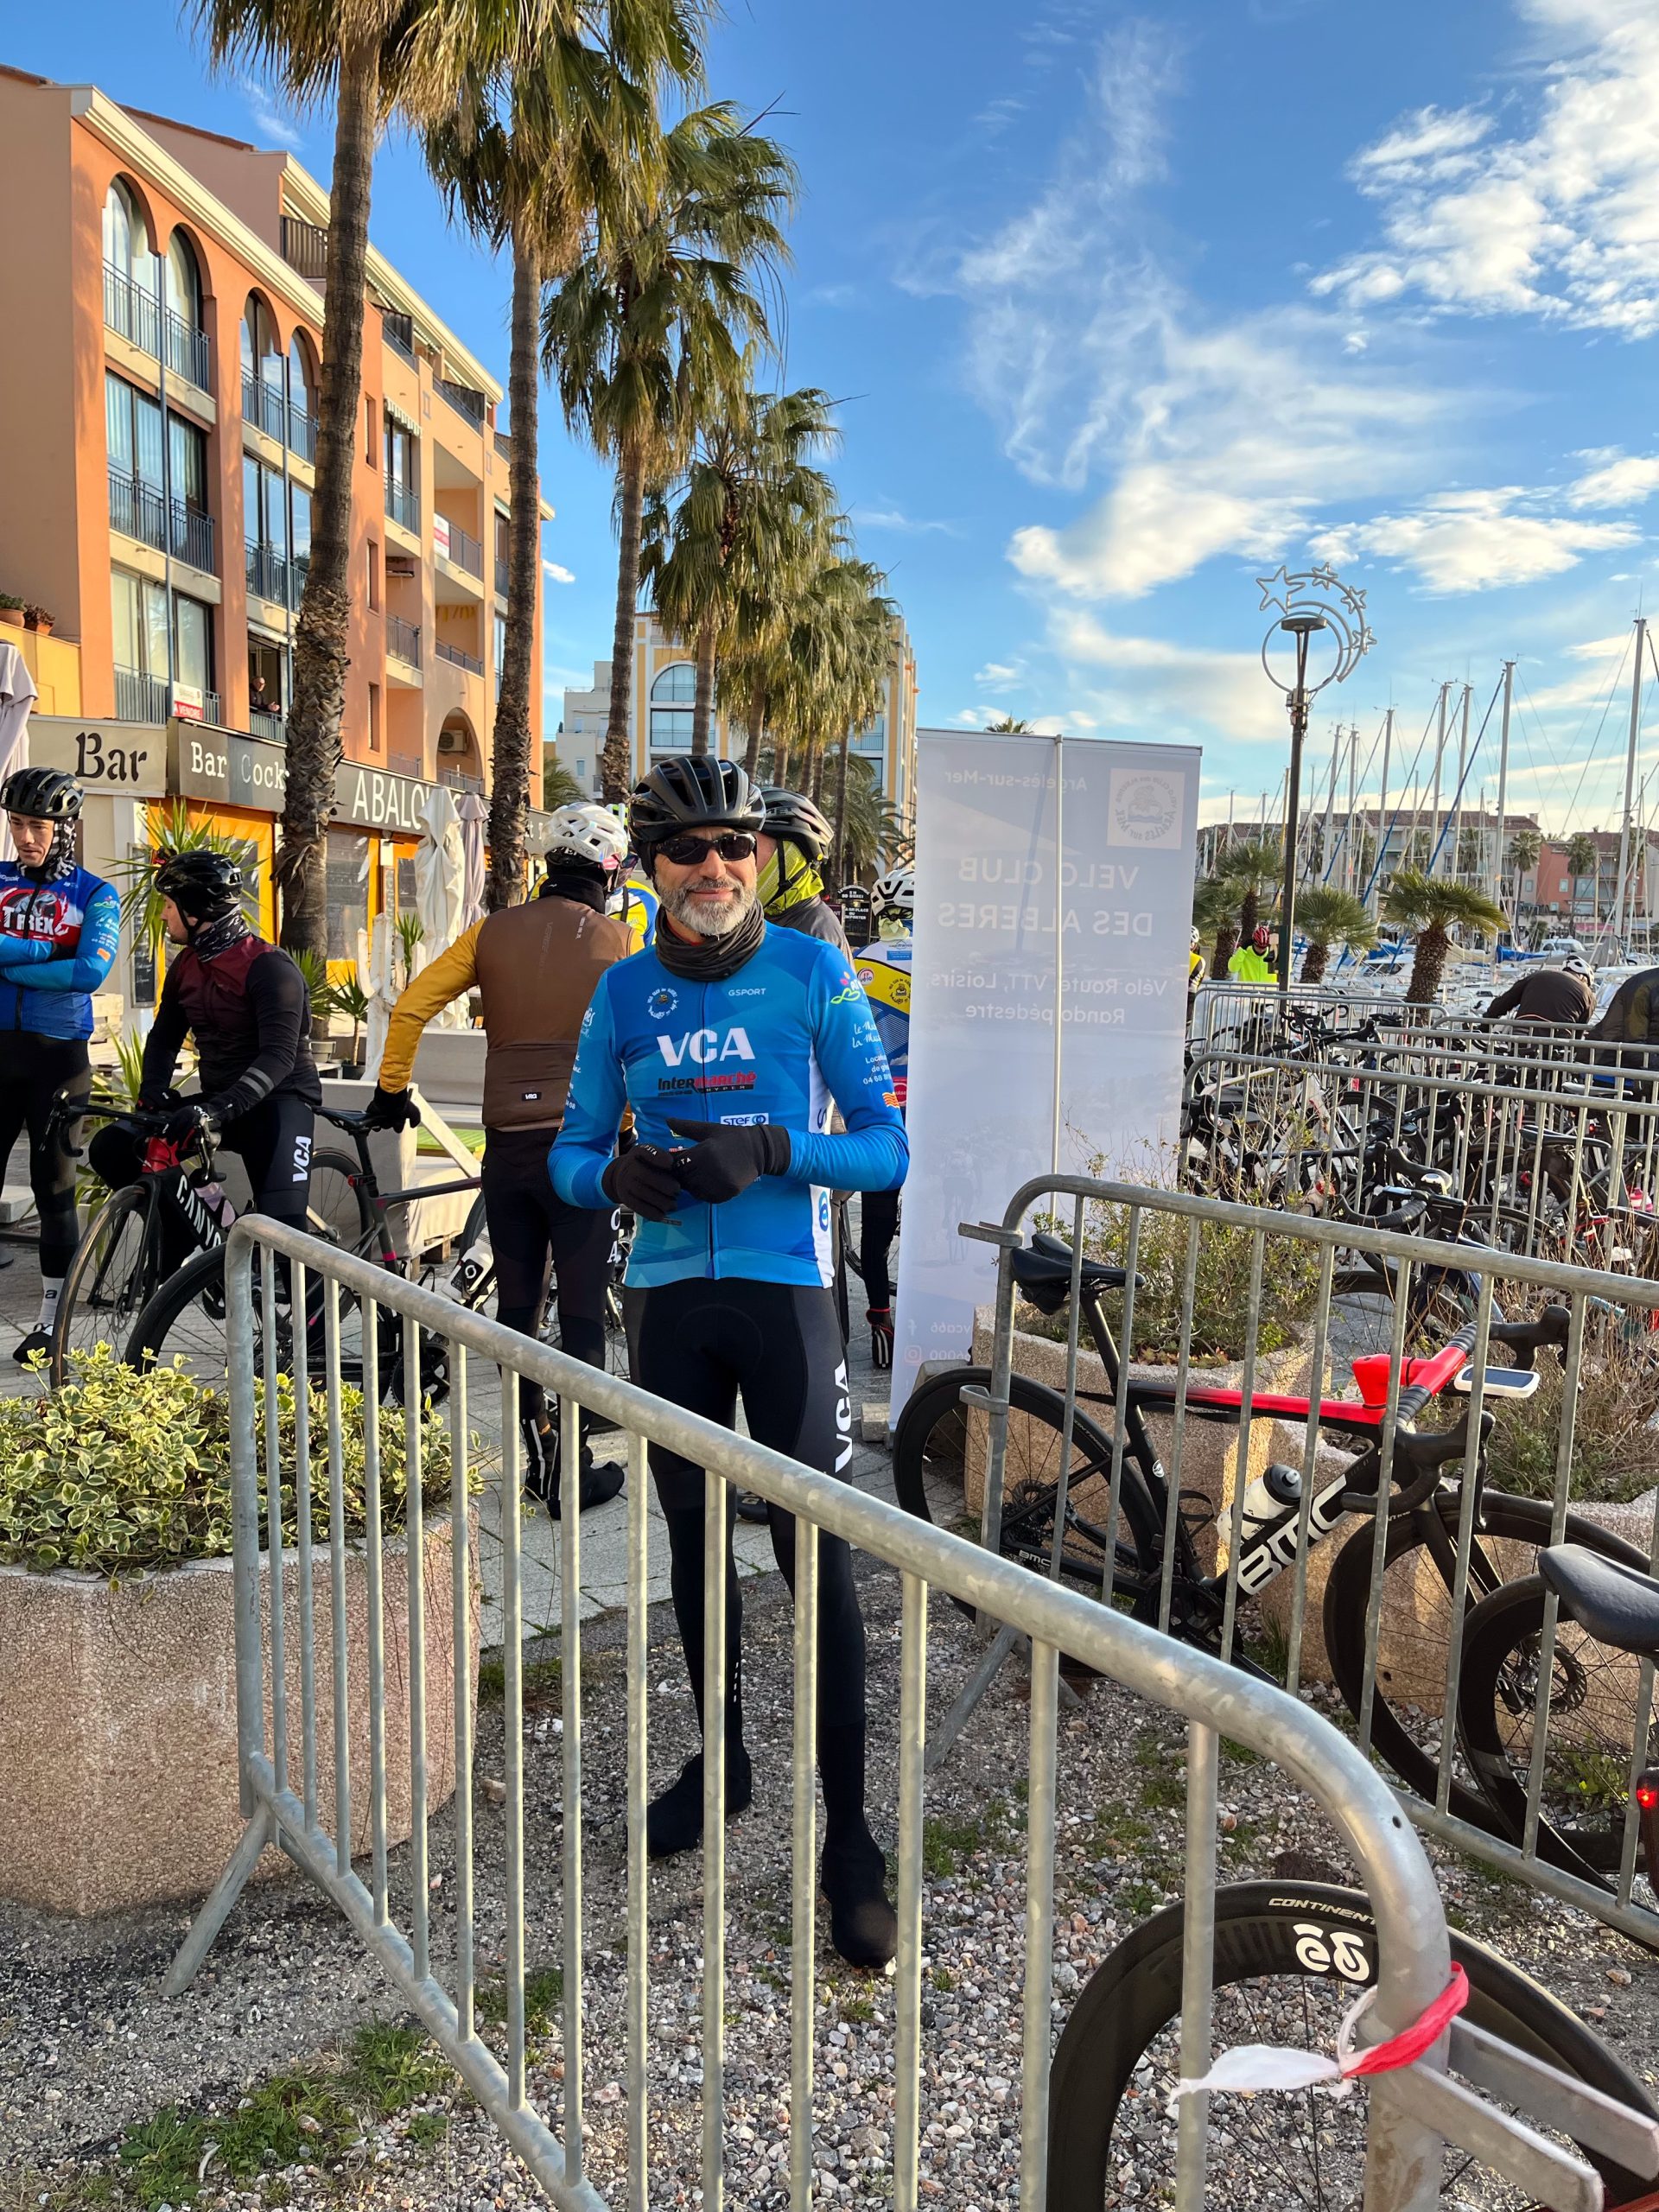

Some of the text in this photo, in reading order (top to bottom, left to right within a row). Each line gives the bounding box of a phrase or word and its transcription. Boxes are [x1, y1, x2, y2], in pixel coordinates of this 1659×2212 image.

[74, 731, 148, 782] Bar
[190, 741, 290, 791] Bar Cock
[352, 770, 461, 830] ABALO
[728, 988, 767, 996] GSPORT
[656, 1027, 756, 1067] VCA
[292, 1135, 312, 1183] VCA
[176, 1174, 222, 1249] CANYO
[834, 1357, 853, 1474] VCA
[1236, 1473, 1347, 1596] BMC
[1268, 1897, 1376, 1926] CONTINENT
